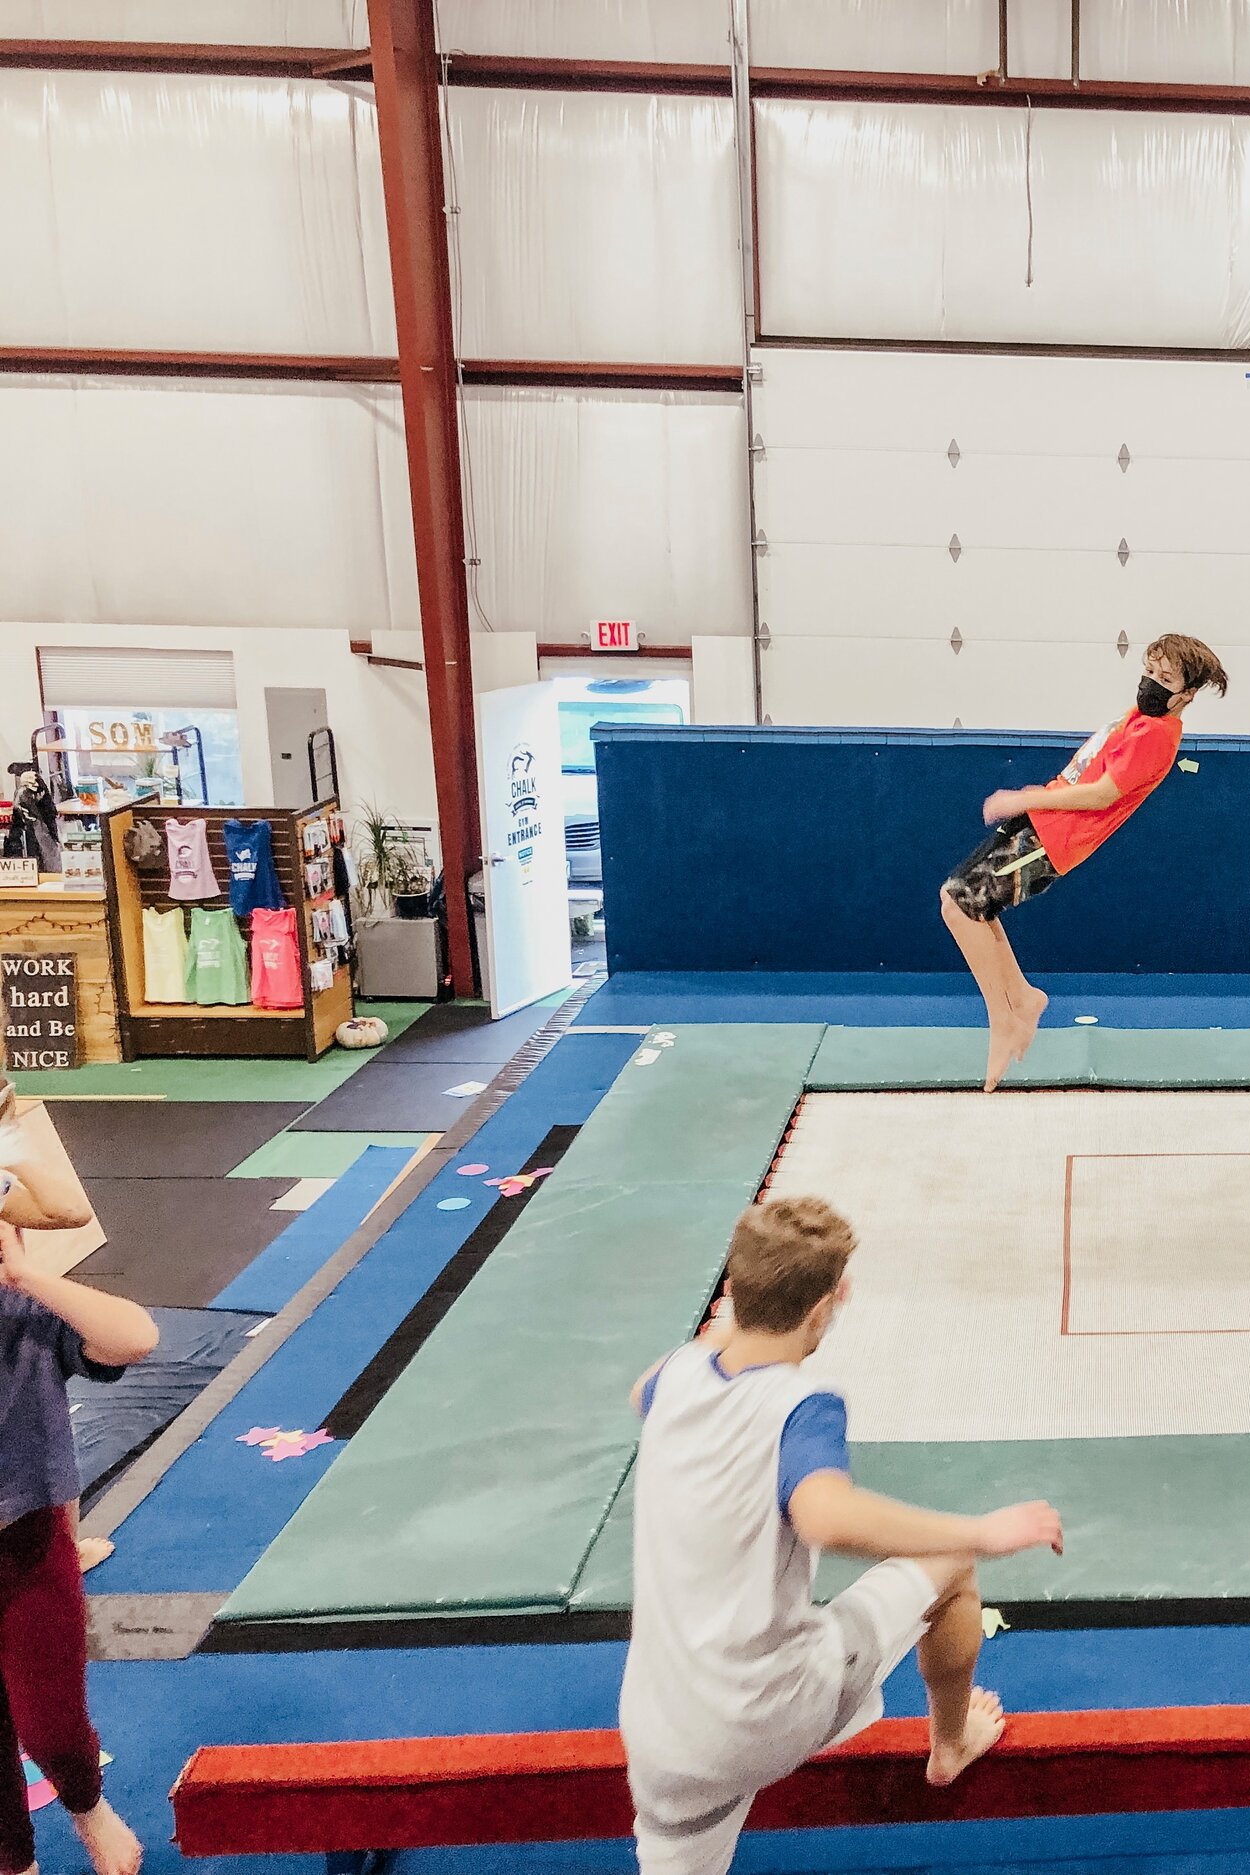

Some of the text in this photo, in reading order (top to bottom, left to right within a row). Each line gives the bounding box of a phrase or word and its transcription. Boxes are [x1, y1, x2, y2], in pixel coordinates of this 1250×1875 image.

[597, 622, 630, 647] EXIT
[89, 721, 154, 747] SOM
[511, 777, 537, 798] CHALK
[518, 816, 529, 828] GYM
[507, 822, 542, 846] ENTRANCE
[1, 959, 74, 976] WORK
[9, 985, 70, 1008] hard
[6, 1020, 76, 1037] and Be
[12, 1051, 70, 1068] NICE
